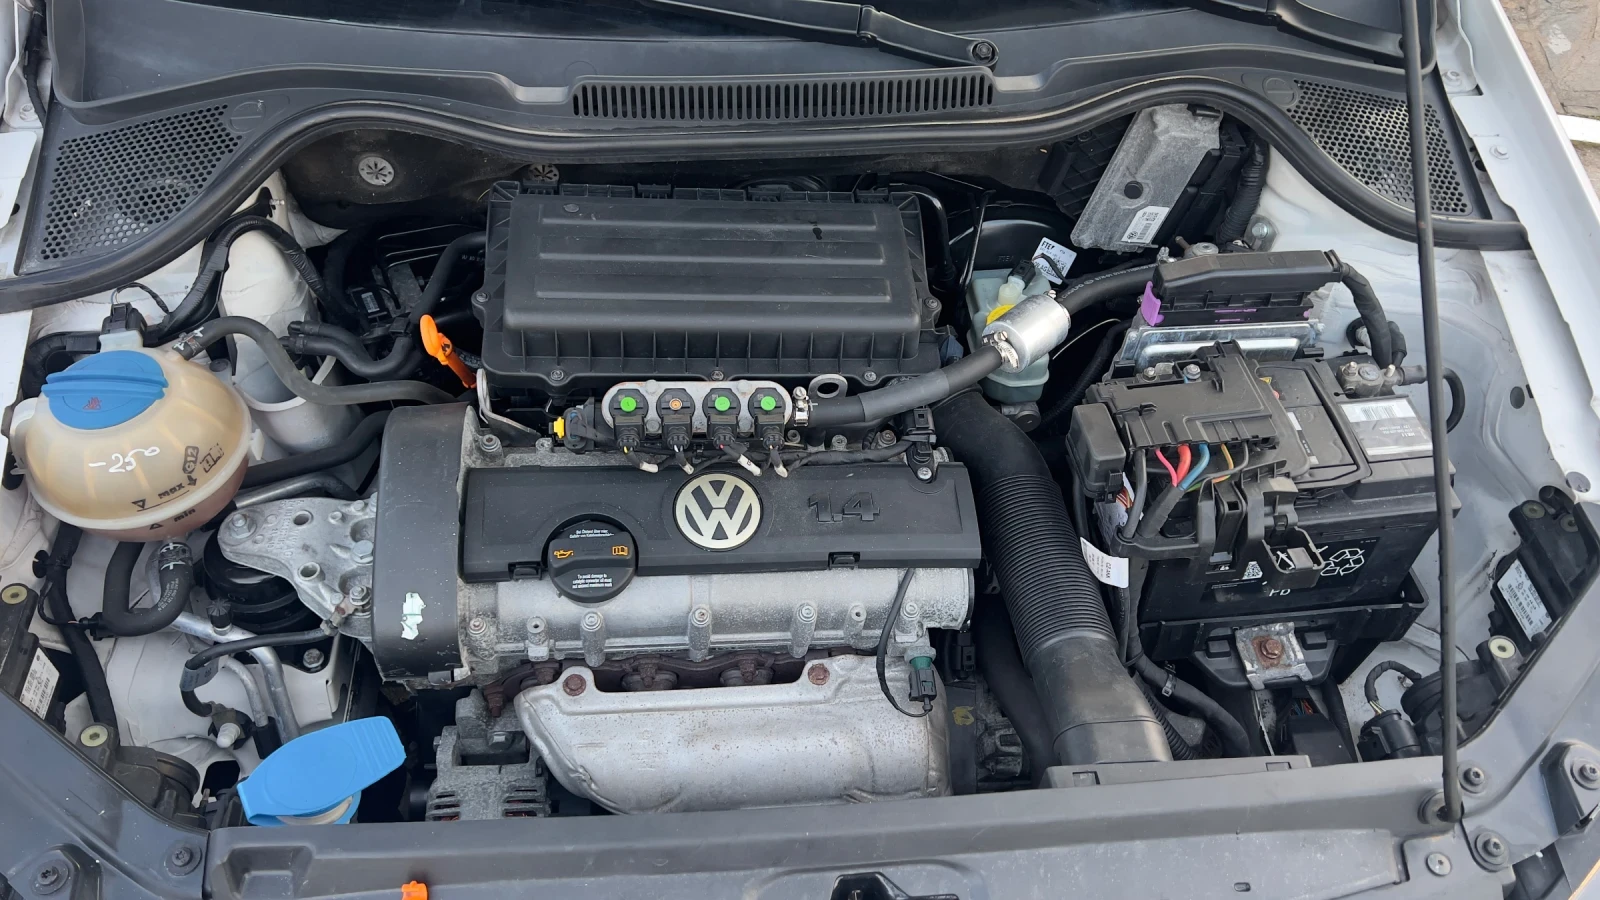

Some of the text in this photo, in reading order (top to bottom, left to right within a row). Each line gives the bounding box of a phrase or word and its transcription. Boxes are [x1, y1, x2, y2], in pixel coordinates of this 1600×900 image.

[158, 482, 185, 499] max
[173, 508, 196, 522] min
[808, 492, 881, 523] 1.4
